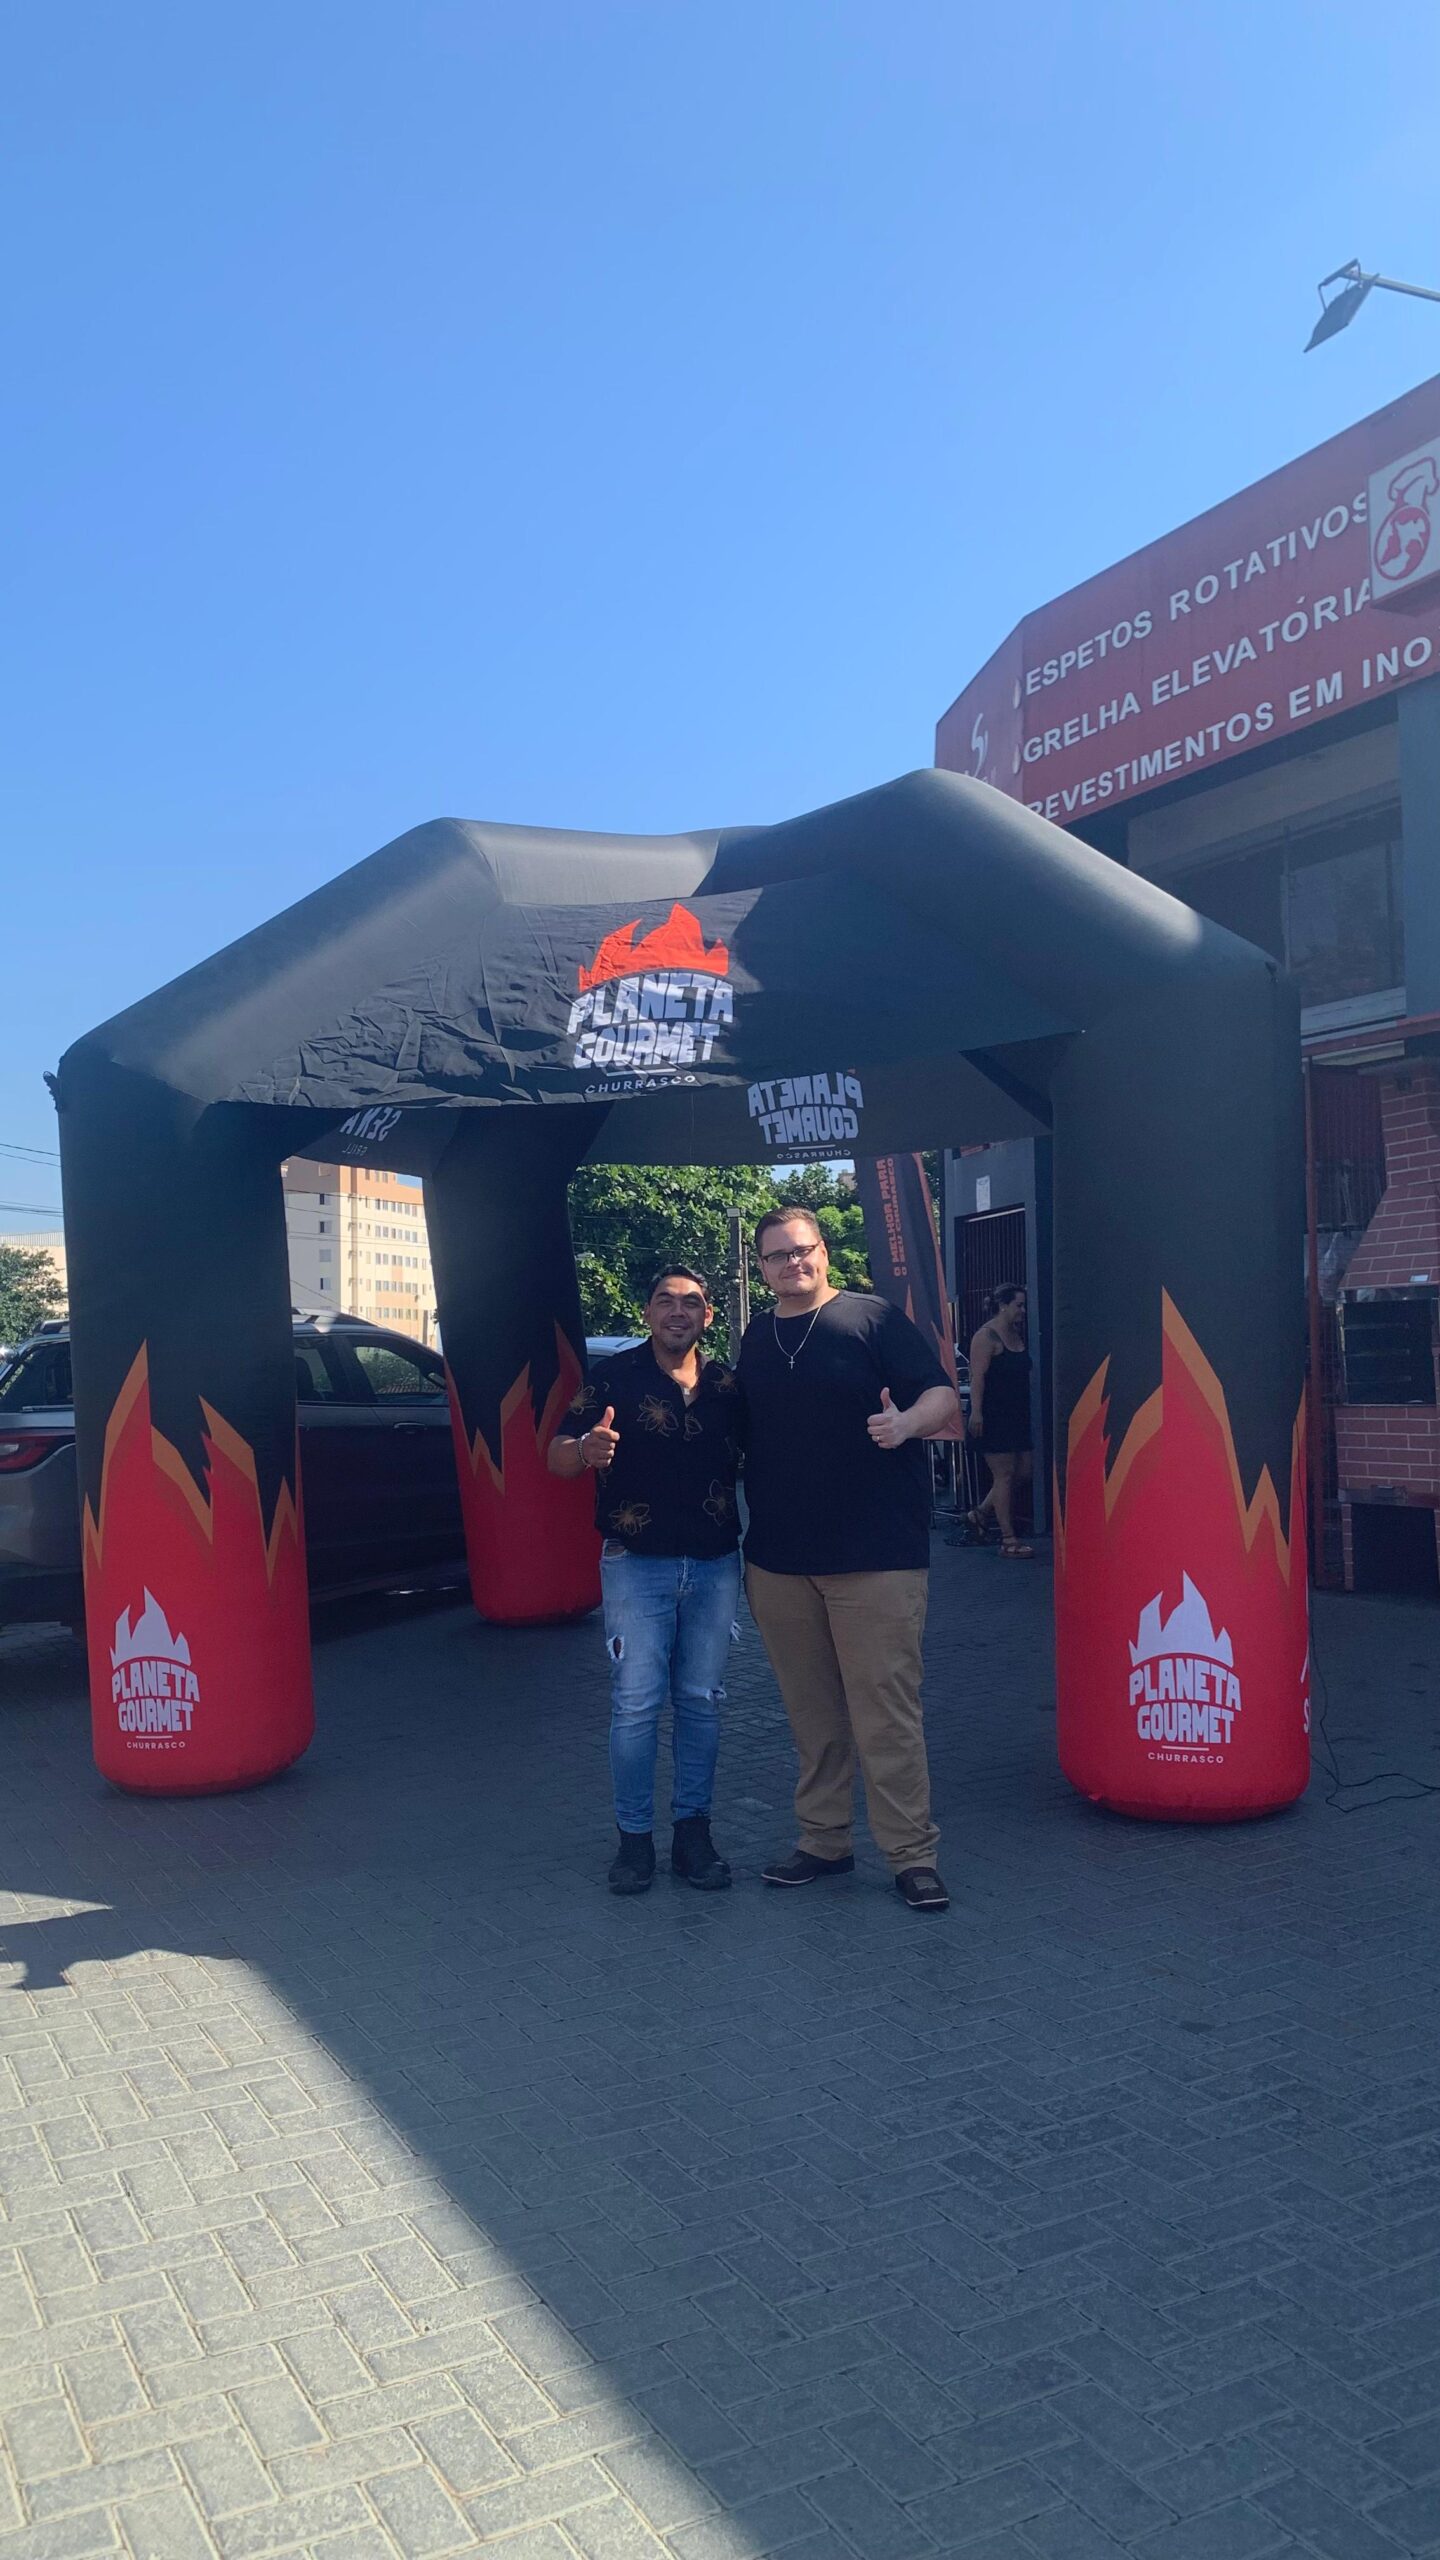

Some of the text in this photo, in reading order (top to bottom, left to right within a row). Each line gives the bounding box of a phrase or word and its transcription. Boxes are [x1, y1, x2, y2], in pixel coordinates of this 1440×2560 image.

[1025, 491, 1367, 697] ESPETOS ROTATIVOS
[1288, 671, 1344, 720] EM
[1362, 636, 1440, 689] INO
[1022, 692, 1141, 764] GRELHA
[567, 972, 734, 1035] PLANETA
[573, 1021, 721, 1070] GOURMET
[585, 1075, 696, 1095] CHURRASCO
[876, 1158, 891, 1200] PARA
[883, 1203, 900, 1263] MELHOR
[897, 1235, 906, 1263] SEU
[111, 1660, 200, 1704] PLANETA
[1128, 1657, 1242, 1712] PLANETA
[117, 1698, 194, 1732] GOURMET
[1137, 1702, 1235, 1744] GOURMET
[126, 1741, 186, 1750] CHURRASCO
[1147, 1752, 1225, 1764] CHURRASCO
